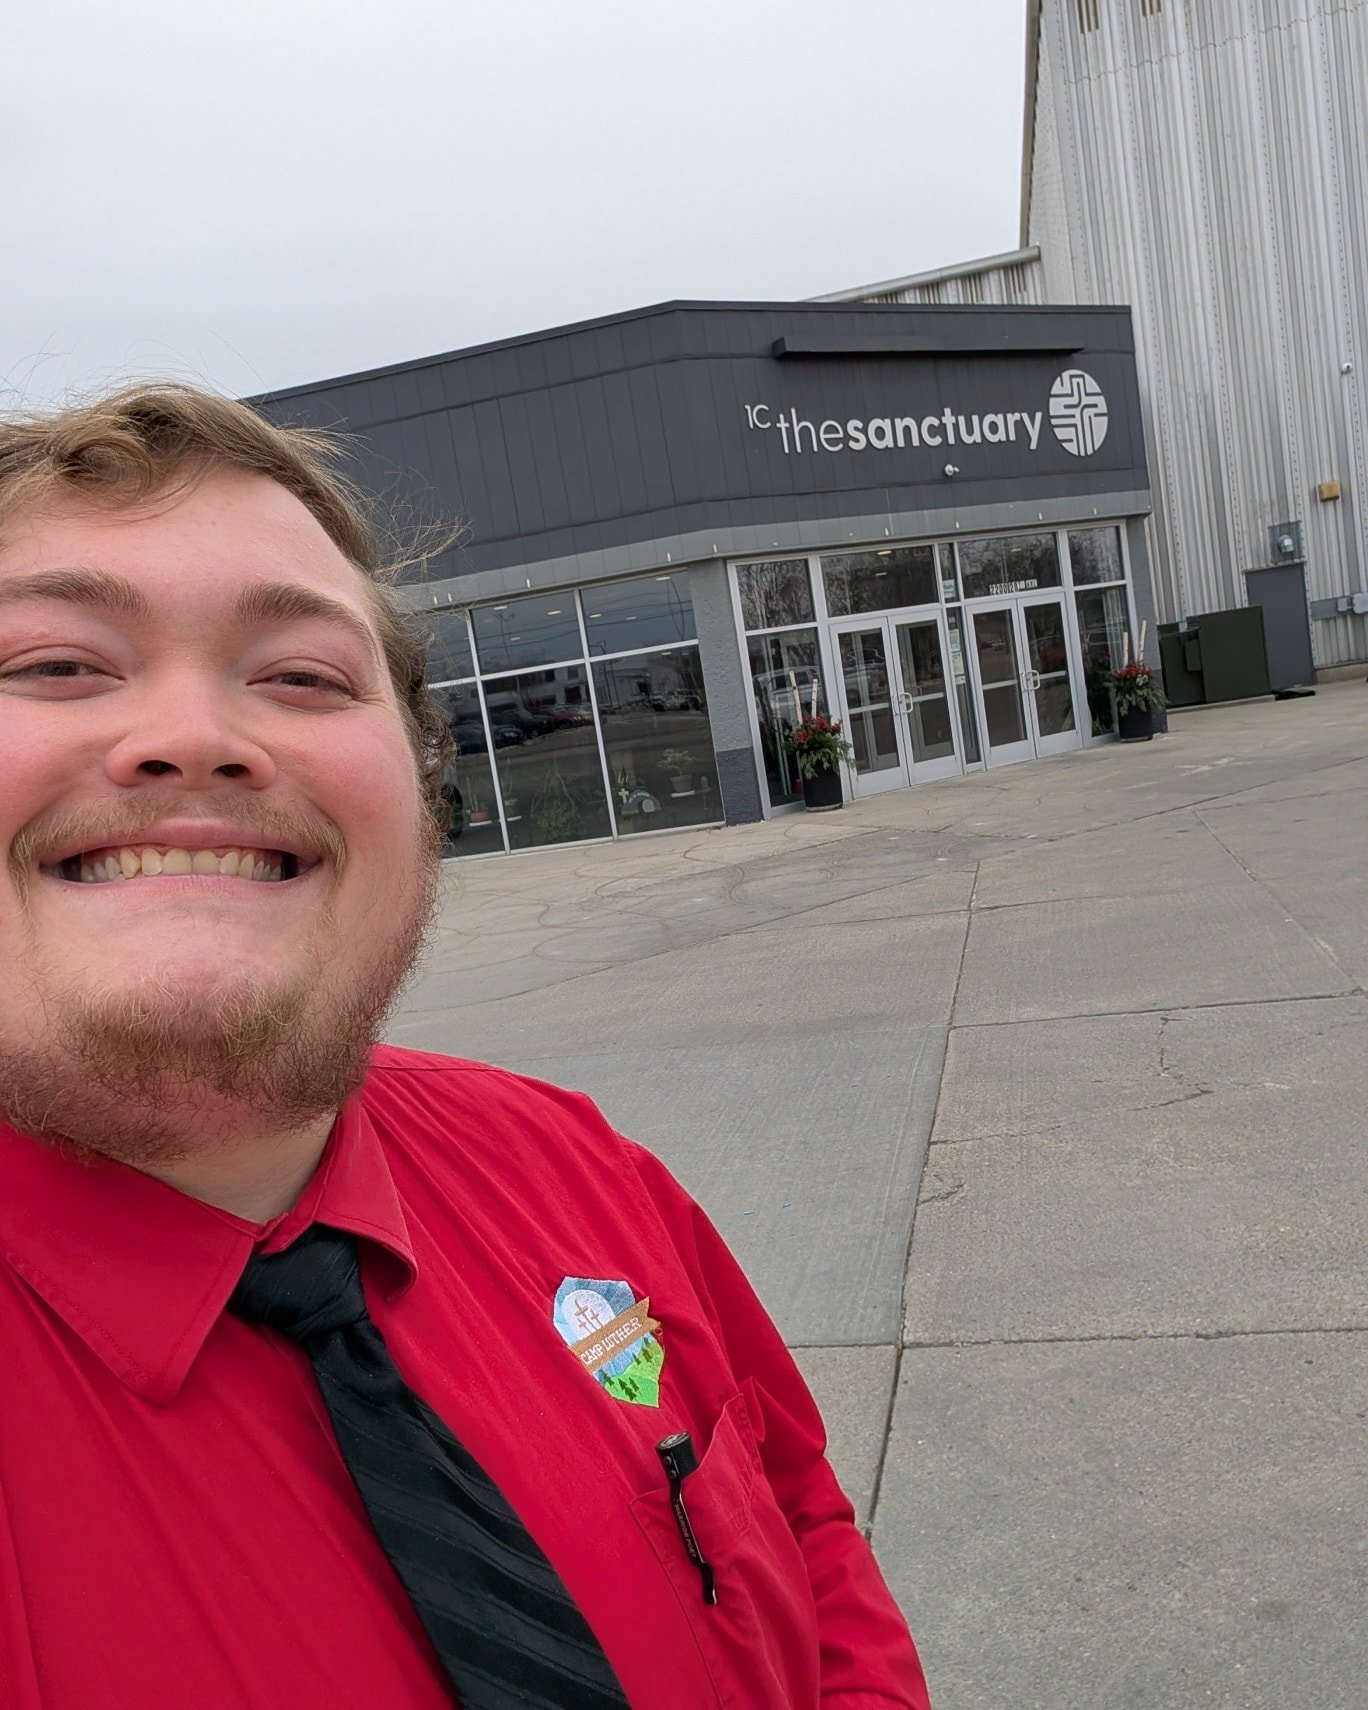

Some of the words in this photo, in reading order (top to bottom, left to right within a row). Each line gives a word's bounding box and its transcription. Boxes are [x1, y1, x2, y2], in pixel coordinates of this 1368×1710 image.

[744, 404, 772, 430] 1C
[580, 1343, 604, 1365] CAMP
[601, 1317, 643, 1352] LUTHER
